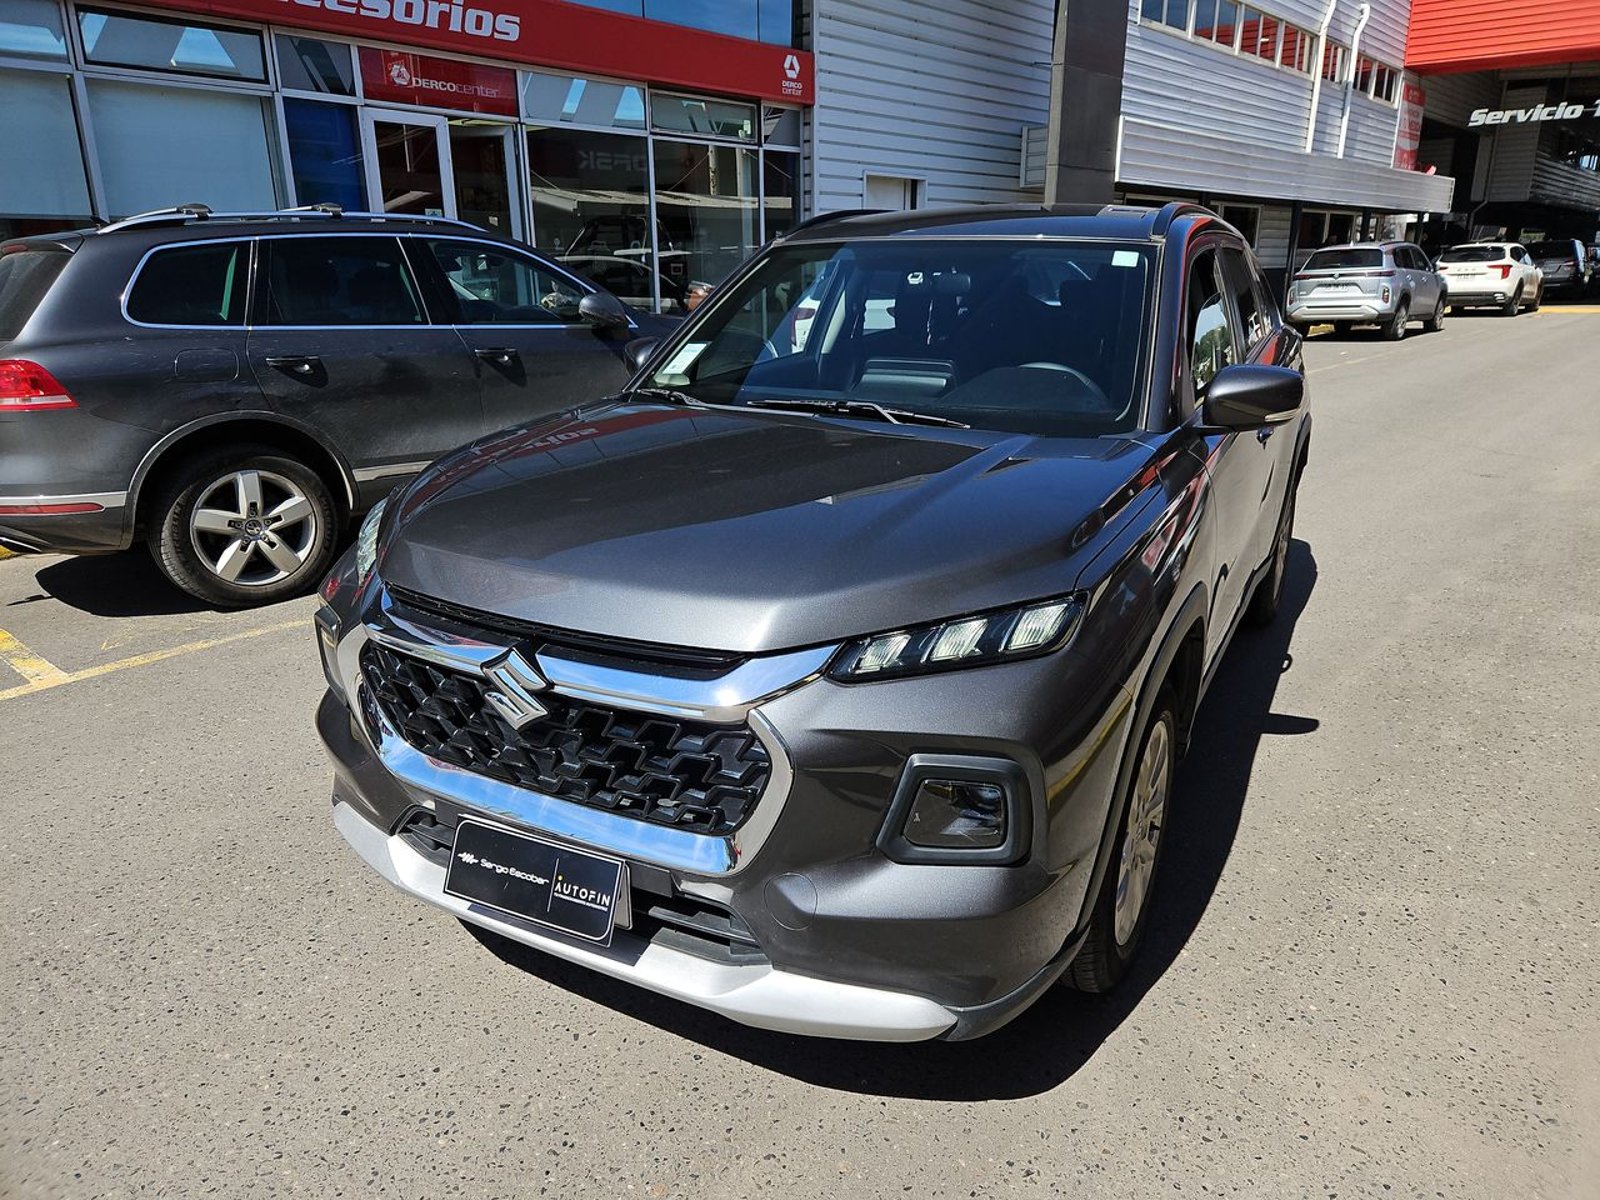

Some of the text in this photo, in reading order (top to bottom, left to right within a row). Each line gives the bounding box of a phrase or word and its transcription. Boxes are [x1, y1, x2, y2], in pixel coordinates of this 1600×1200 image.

[411, 76, 499, 98] DERCOcenter
[1467, 101, 1585, 127] Servicio
[554, 881, 610, 906] AUTOFIN
